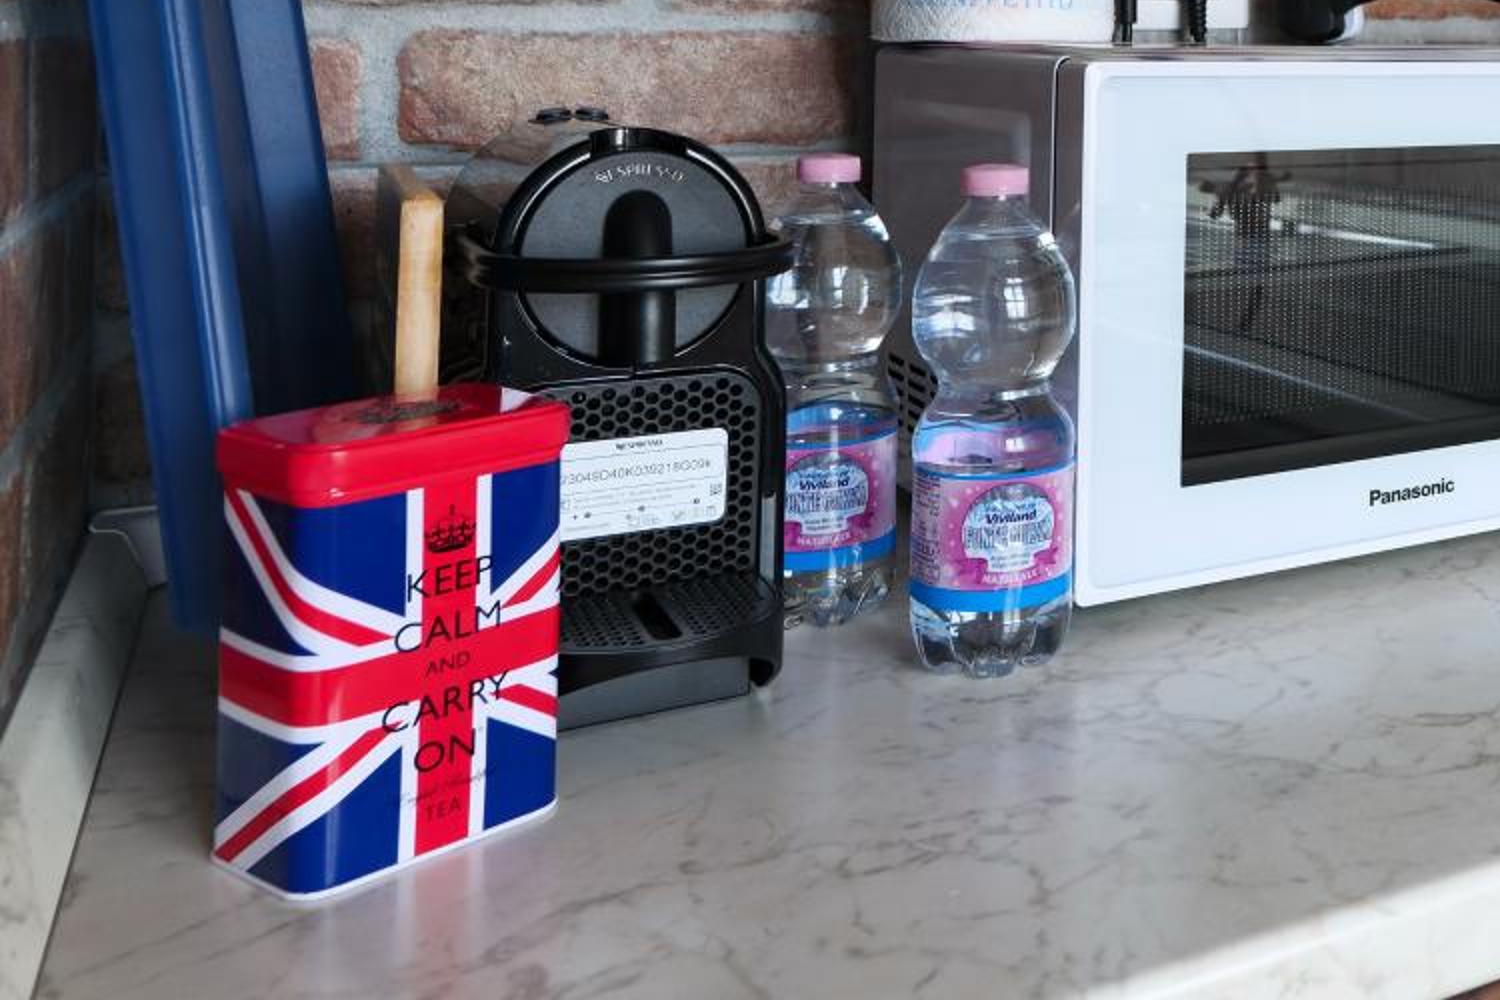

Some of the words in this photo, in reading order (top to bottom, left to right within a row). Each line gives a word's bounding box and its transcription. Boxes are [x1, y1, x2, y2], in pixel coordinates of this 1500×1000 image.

[1368, 477, 1455, 507] Panasonic
[985, 508, 1037, 525] Viviland
[407, 554, 494, 603] KEEP
[394, 599, 501, 652] CALM
[424, 650, 471, 678] AND
[382, 670, 509, 732] CARRY
[413, 728, 477, 773] ON
[424, 796, 461, 823] TEA
